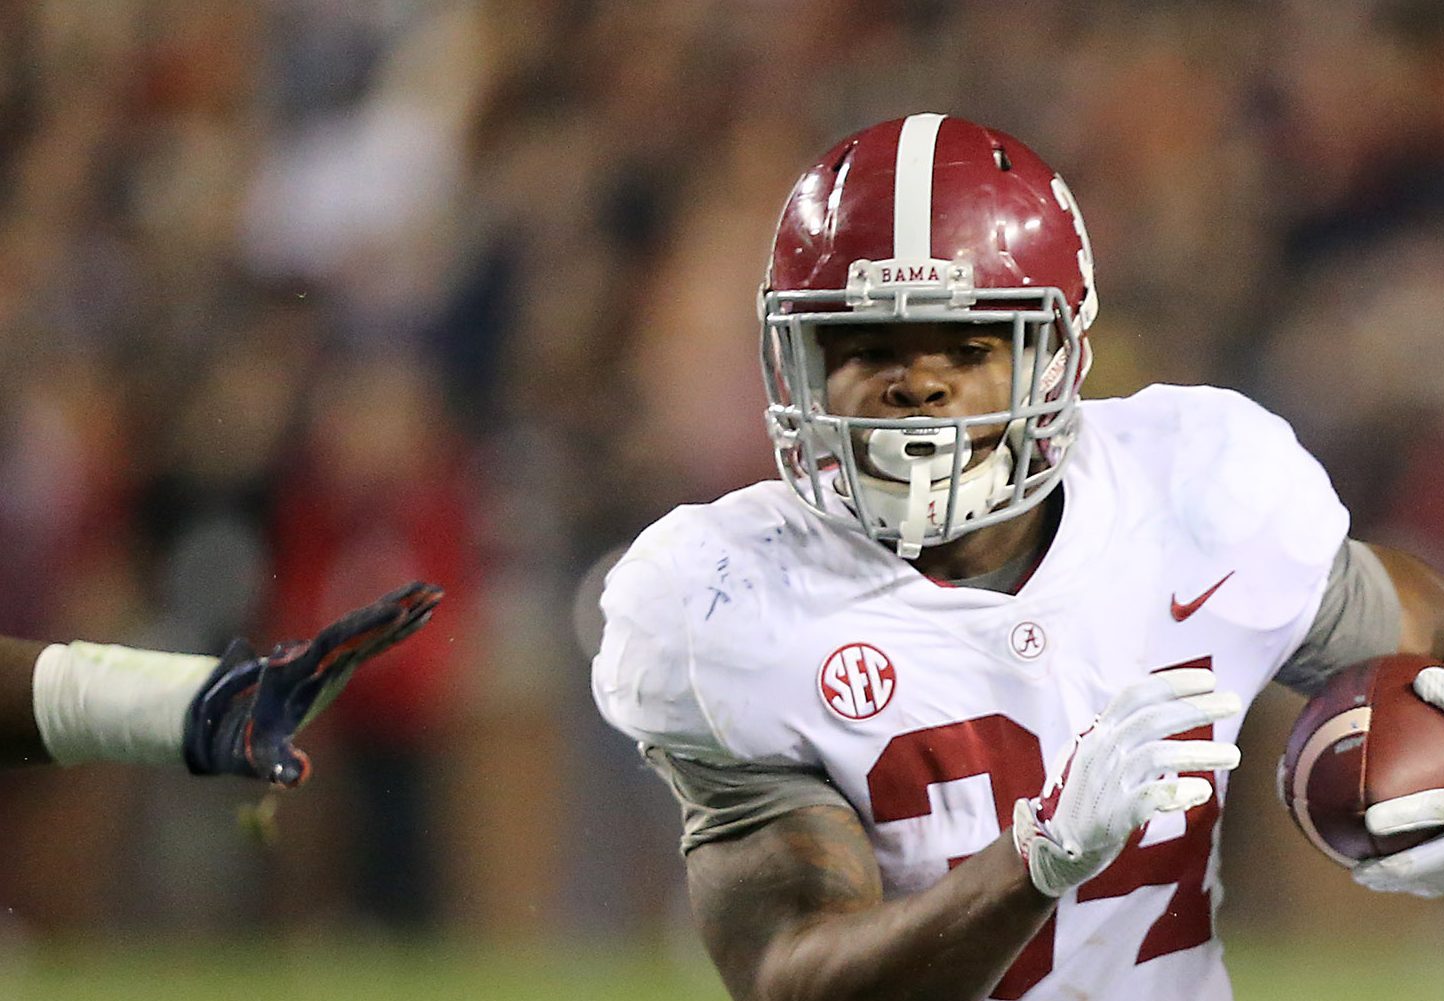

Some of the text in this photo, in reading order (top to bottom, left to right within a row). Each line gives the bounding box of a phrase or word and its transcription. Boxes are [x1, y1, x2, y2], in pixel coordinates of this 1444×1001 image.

[881, 266, 940, 283] BAMA
[1020, 626, 1039, 653] A
[823, 645, 895, 716] SEC
